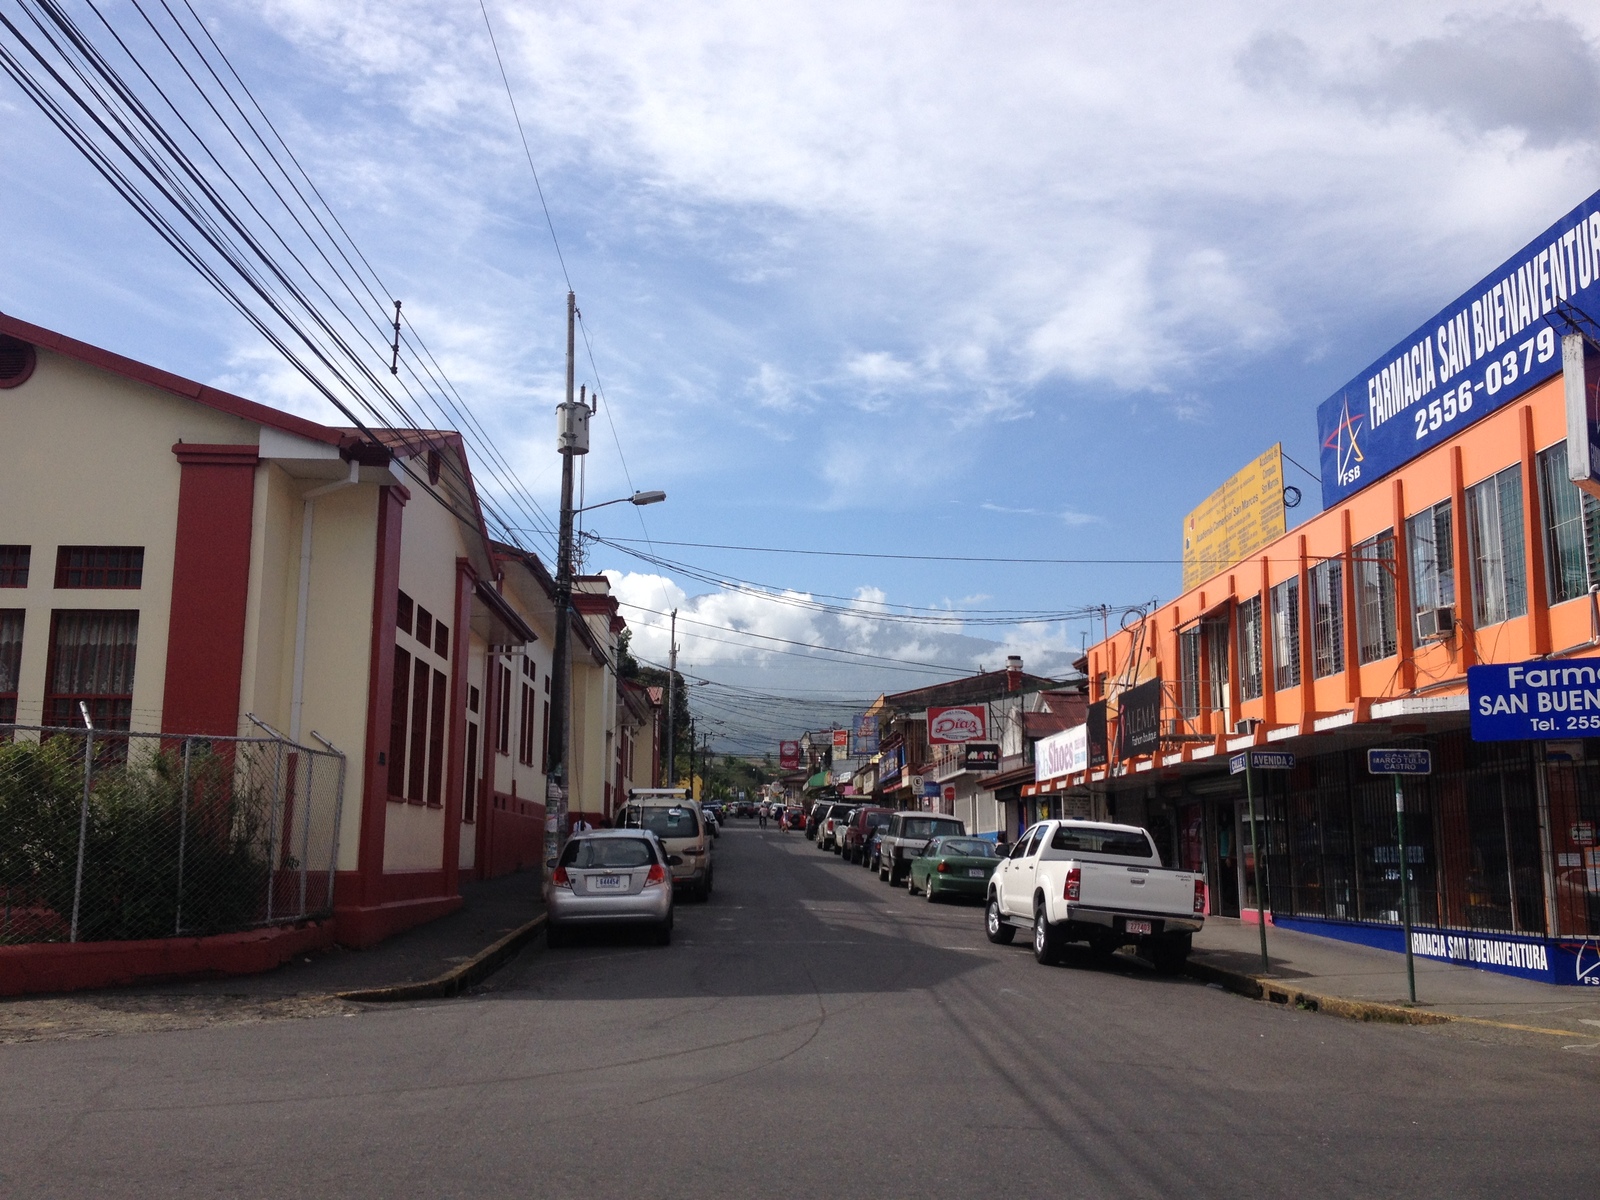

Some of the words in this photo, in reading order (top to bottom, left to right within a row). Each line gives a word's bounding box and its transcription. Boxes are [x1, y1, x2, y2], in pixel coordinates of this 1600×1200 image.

[1367, 336, 1437, 431] FARMACIA
[1437, 308, 1472, 384] SAN
[1414, 326, 1556, 440] 2556-0379
[1342, 465, 1362, 487] FSB
[1241, 493, 1259, 510] Marcos
[1507, 666, 1600, 689] Farm
[1479, 693, 1528, 716] SAN
[1537, 689, 1600, 713] BUEN
[1530, 718, 1560, 732] Tel.
[1566, 715, 1600, 730] 255
[1048, 740, 1073, 775] Shoes
[1253, 755, 1287, 766] AVENIDA
[1288, 757, 1294, 766] 2
[1384, 763, 1417, 771] CASTRO
[1404, 757, 1427, 765] TULIO
[1447, 935, 1467, 961] SAN
[1468, 938, 1549, 971] BUENAVENTURA
